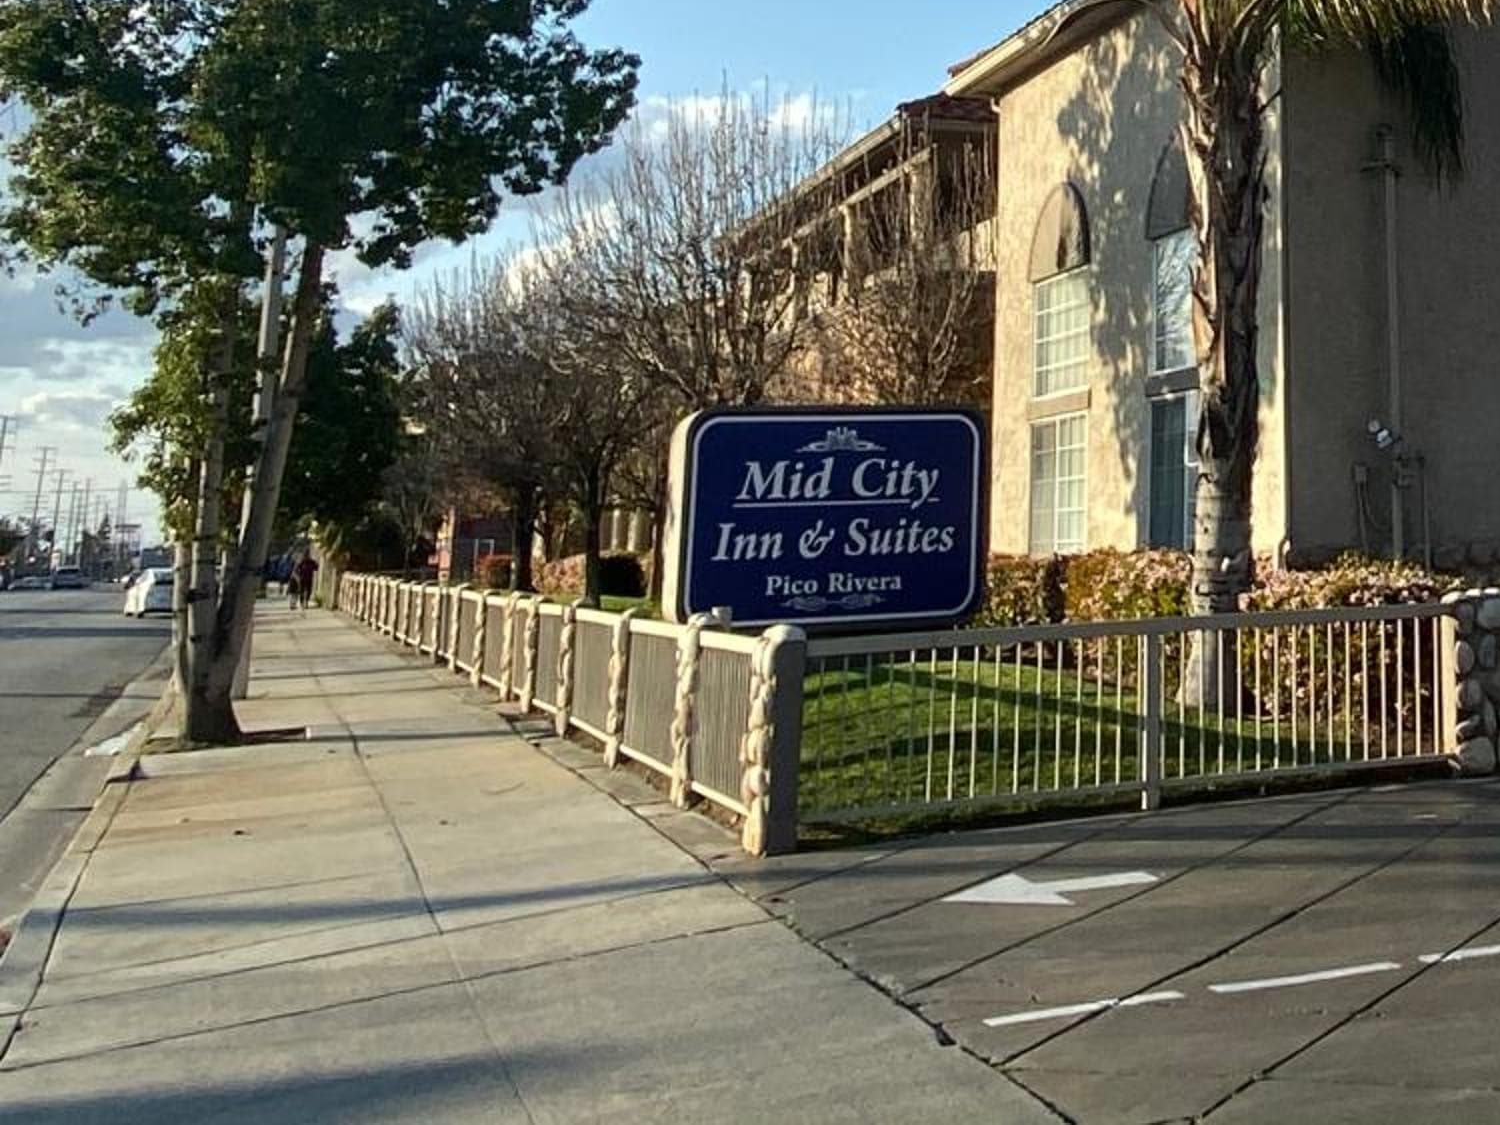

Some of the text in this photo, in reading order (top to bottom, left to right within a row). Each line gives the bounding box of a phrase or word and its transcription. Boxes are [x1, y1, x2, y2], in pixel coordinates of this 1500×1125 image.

[735, 457, 940, 509] Mid City
[710, 518, 956, 561] Inn & Suites
[765, 572, 902, 596] Pico Rivera
